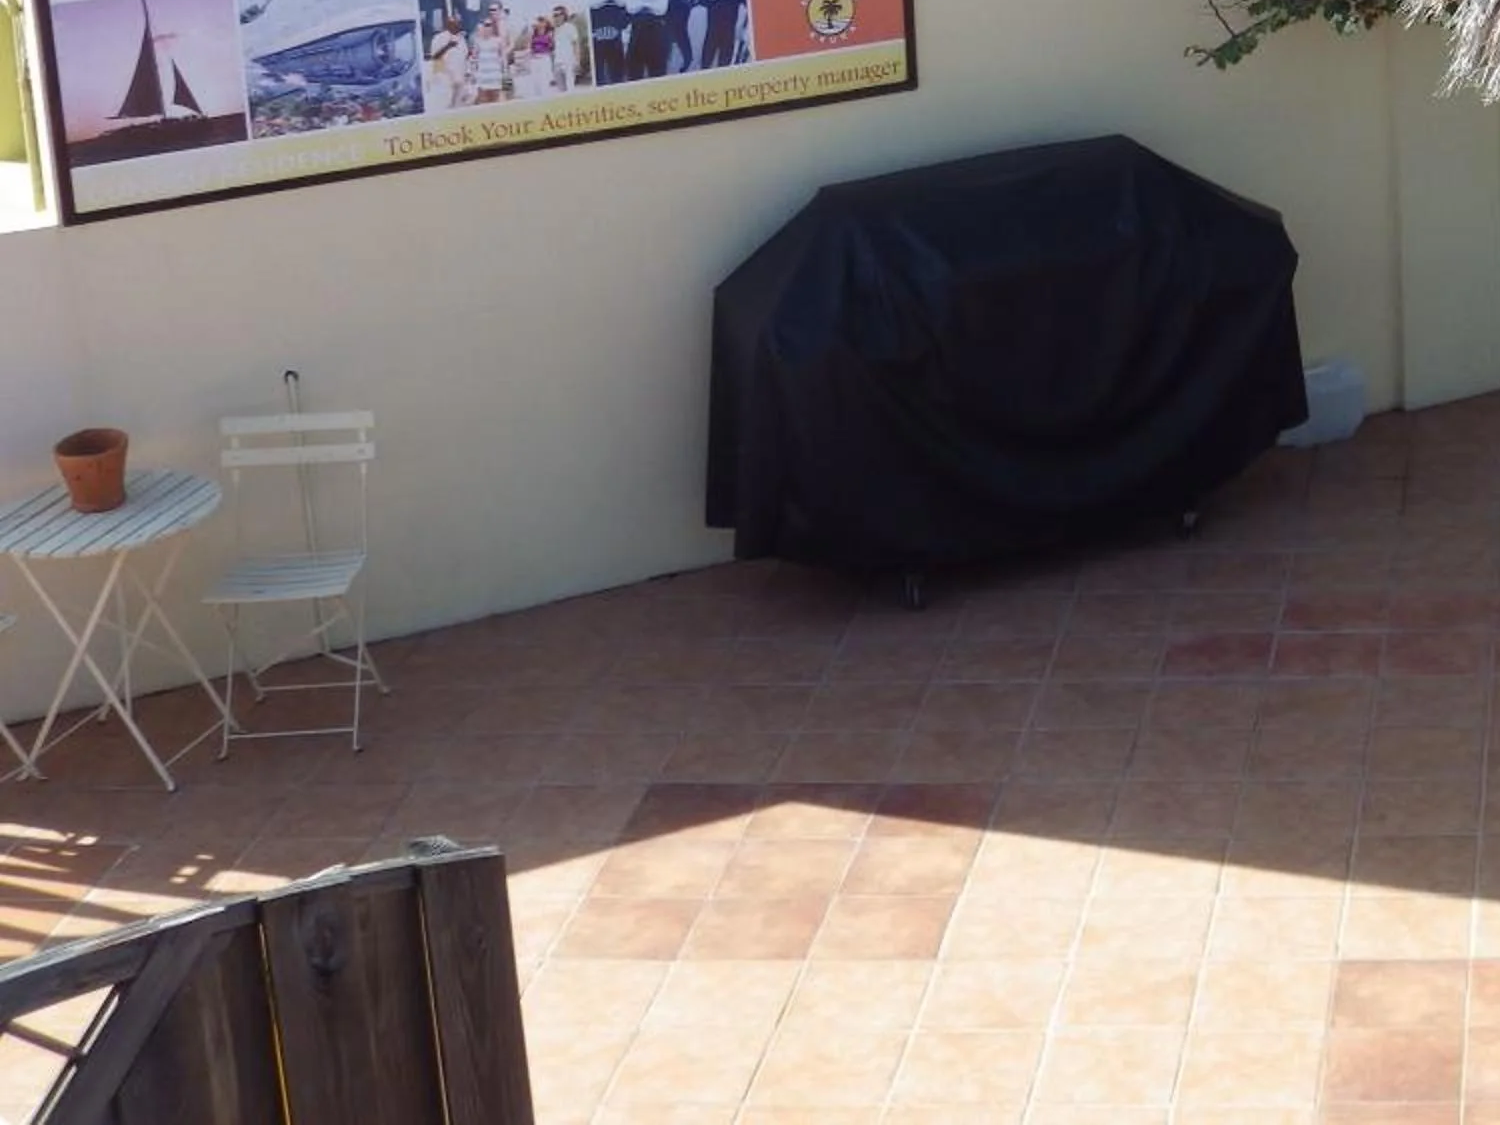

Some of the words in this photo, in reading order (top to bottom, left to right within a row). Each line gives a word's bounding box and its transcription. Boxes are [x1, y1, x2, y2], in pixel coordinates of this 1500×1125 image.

[383, 137, 413, 156] To
[420, 126, 473, 151] Book
[481, 119, 533, 141] Your
[540, 103, 642, 132] Activities,
[649, 96, 679, 115] see
[685, 88, 718, 109] the
[724, 76, 811, 107] property
[816, 60, 900, 86] manager
